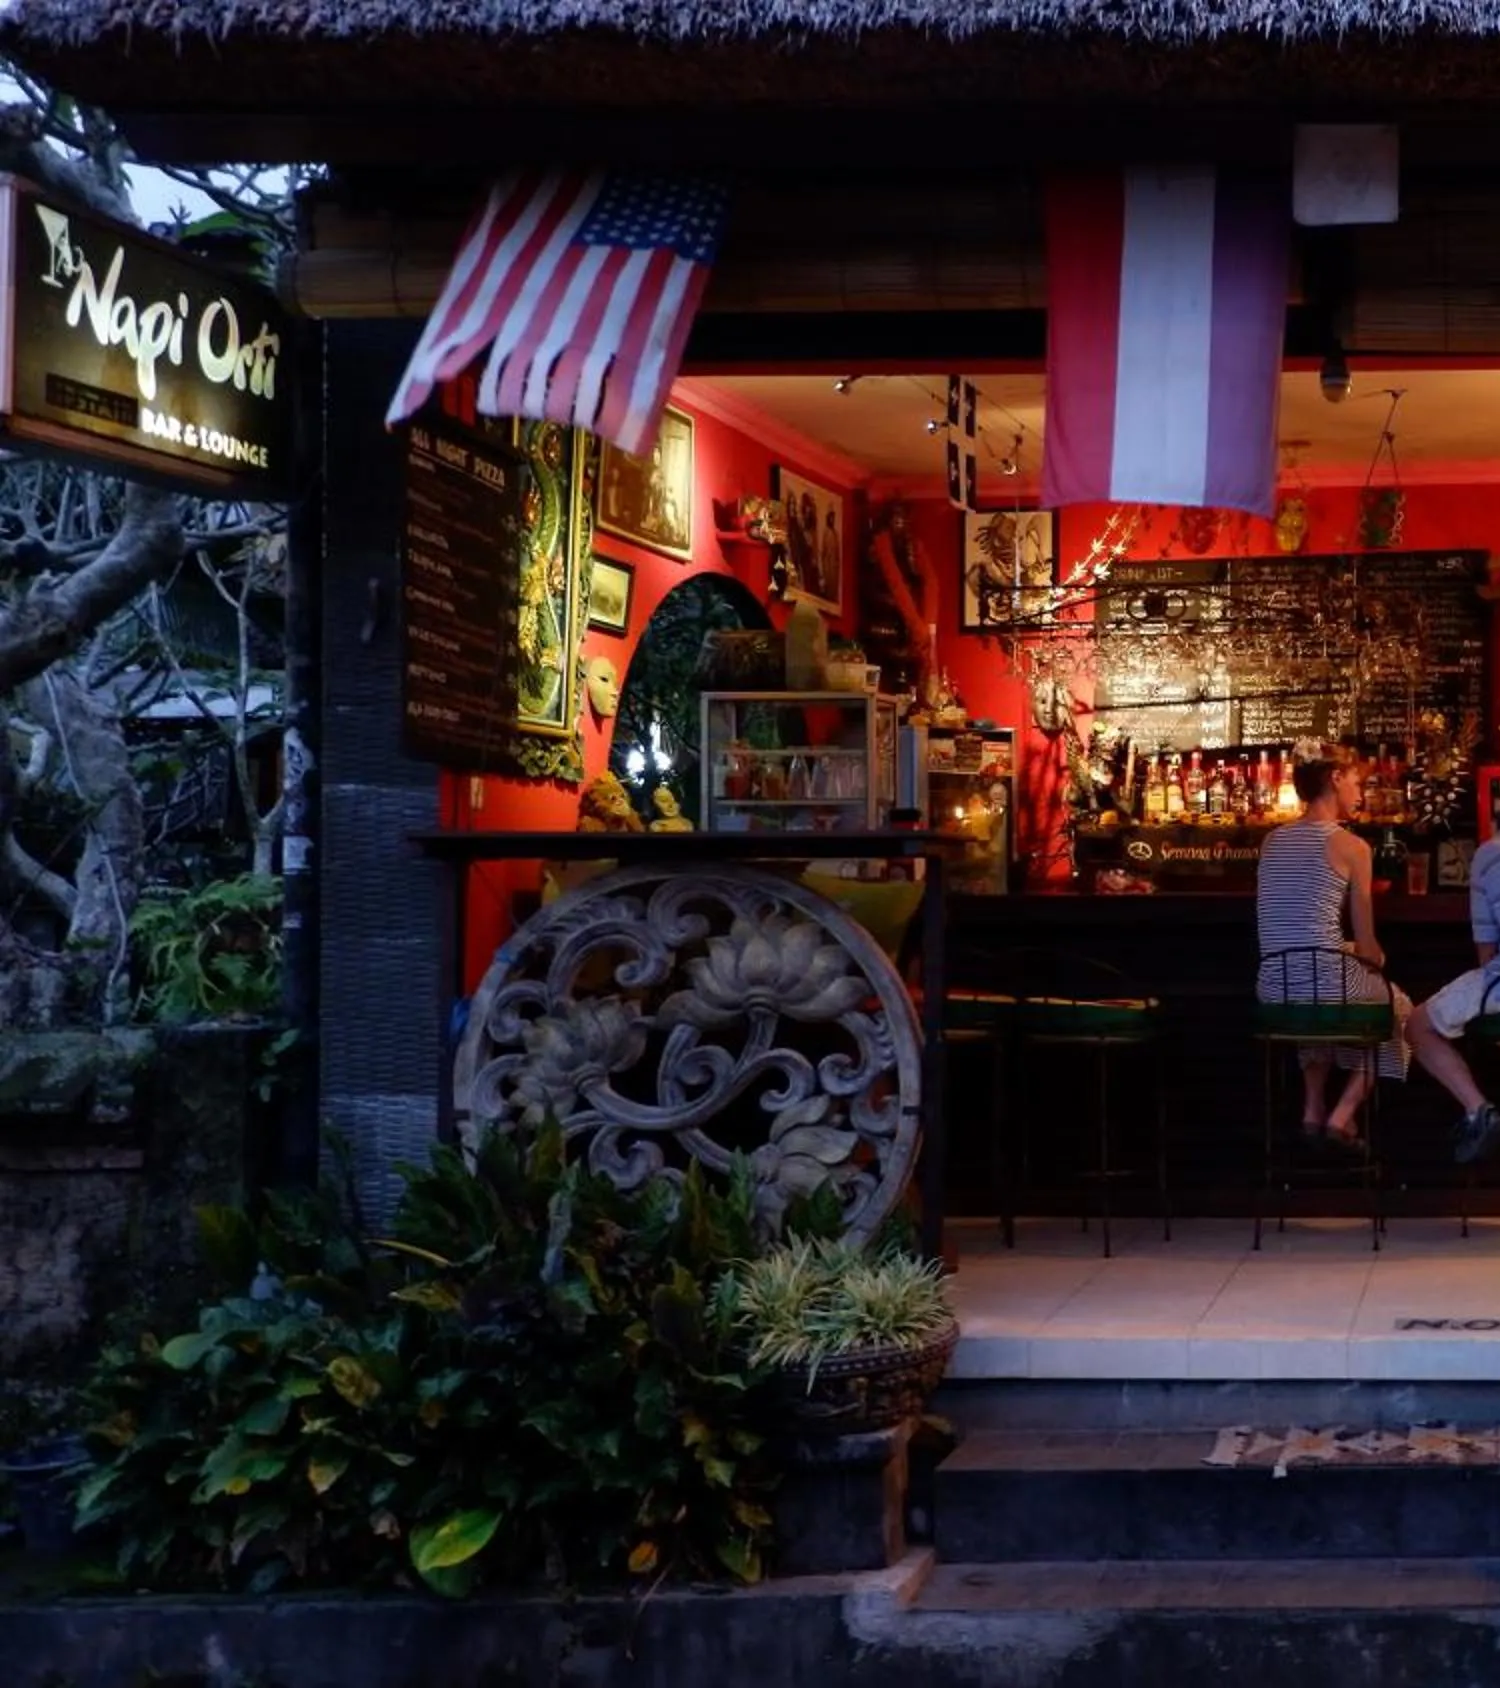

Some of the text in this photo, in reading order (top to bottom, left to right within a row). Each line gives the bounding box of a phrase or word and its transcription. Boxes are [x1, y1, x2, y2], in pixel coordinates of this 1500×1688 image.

[66, 246, 280, 400] Napi Orti
[141, 407, 269, 469] BAR & LOUNGE
